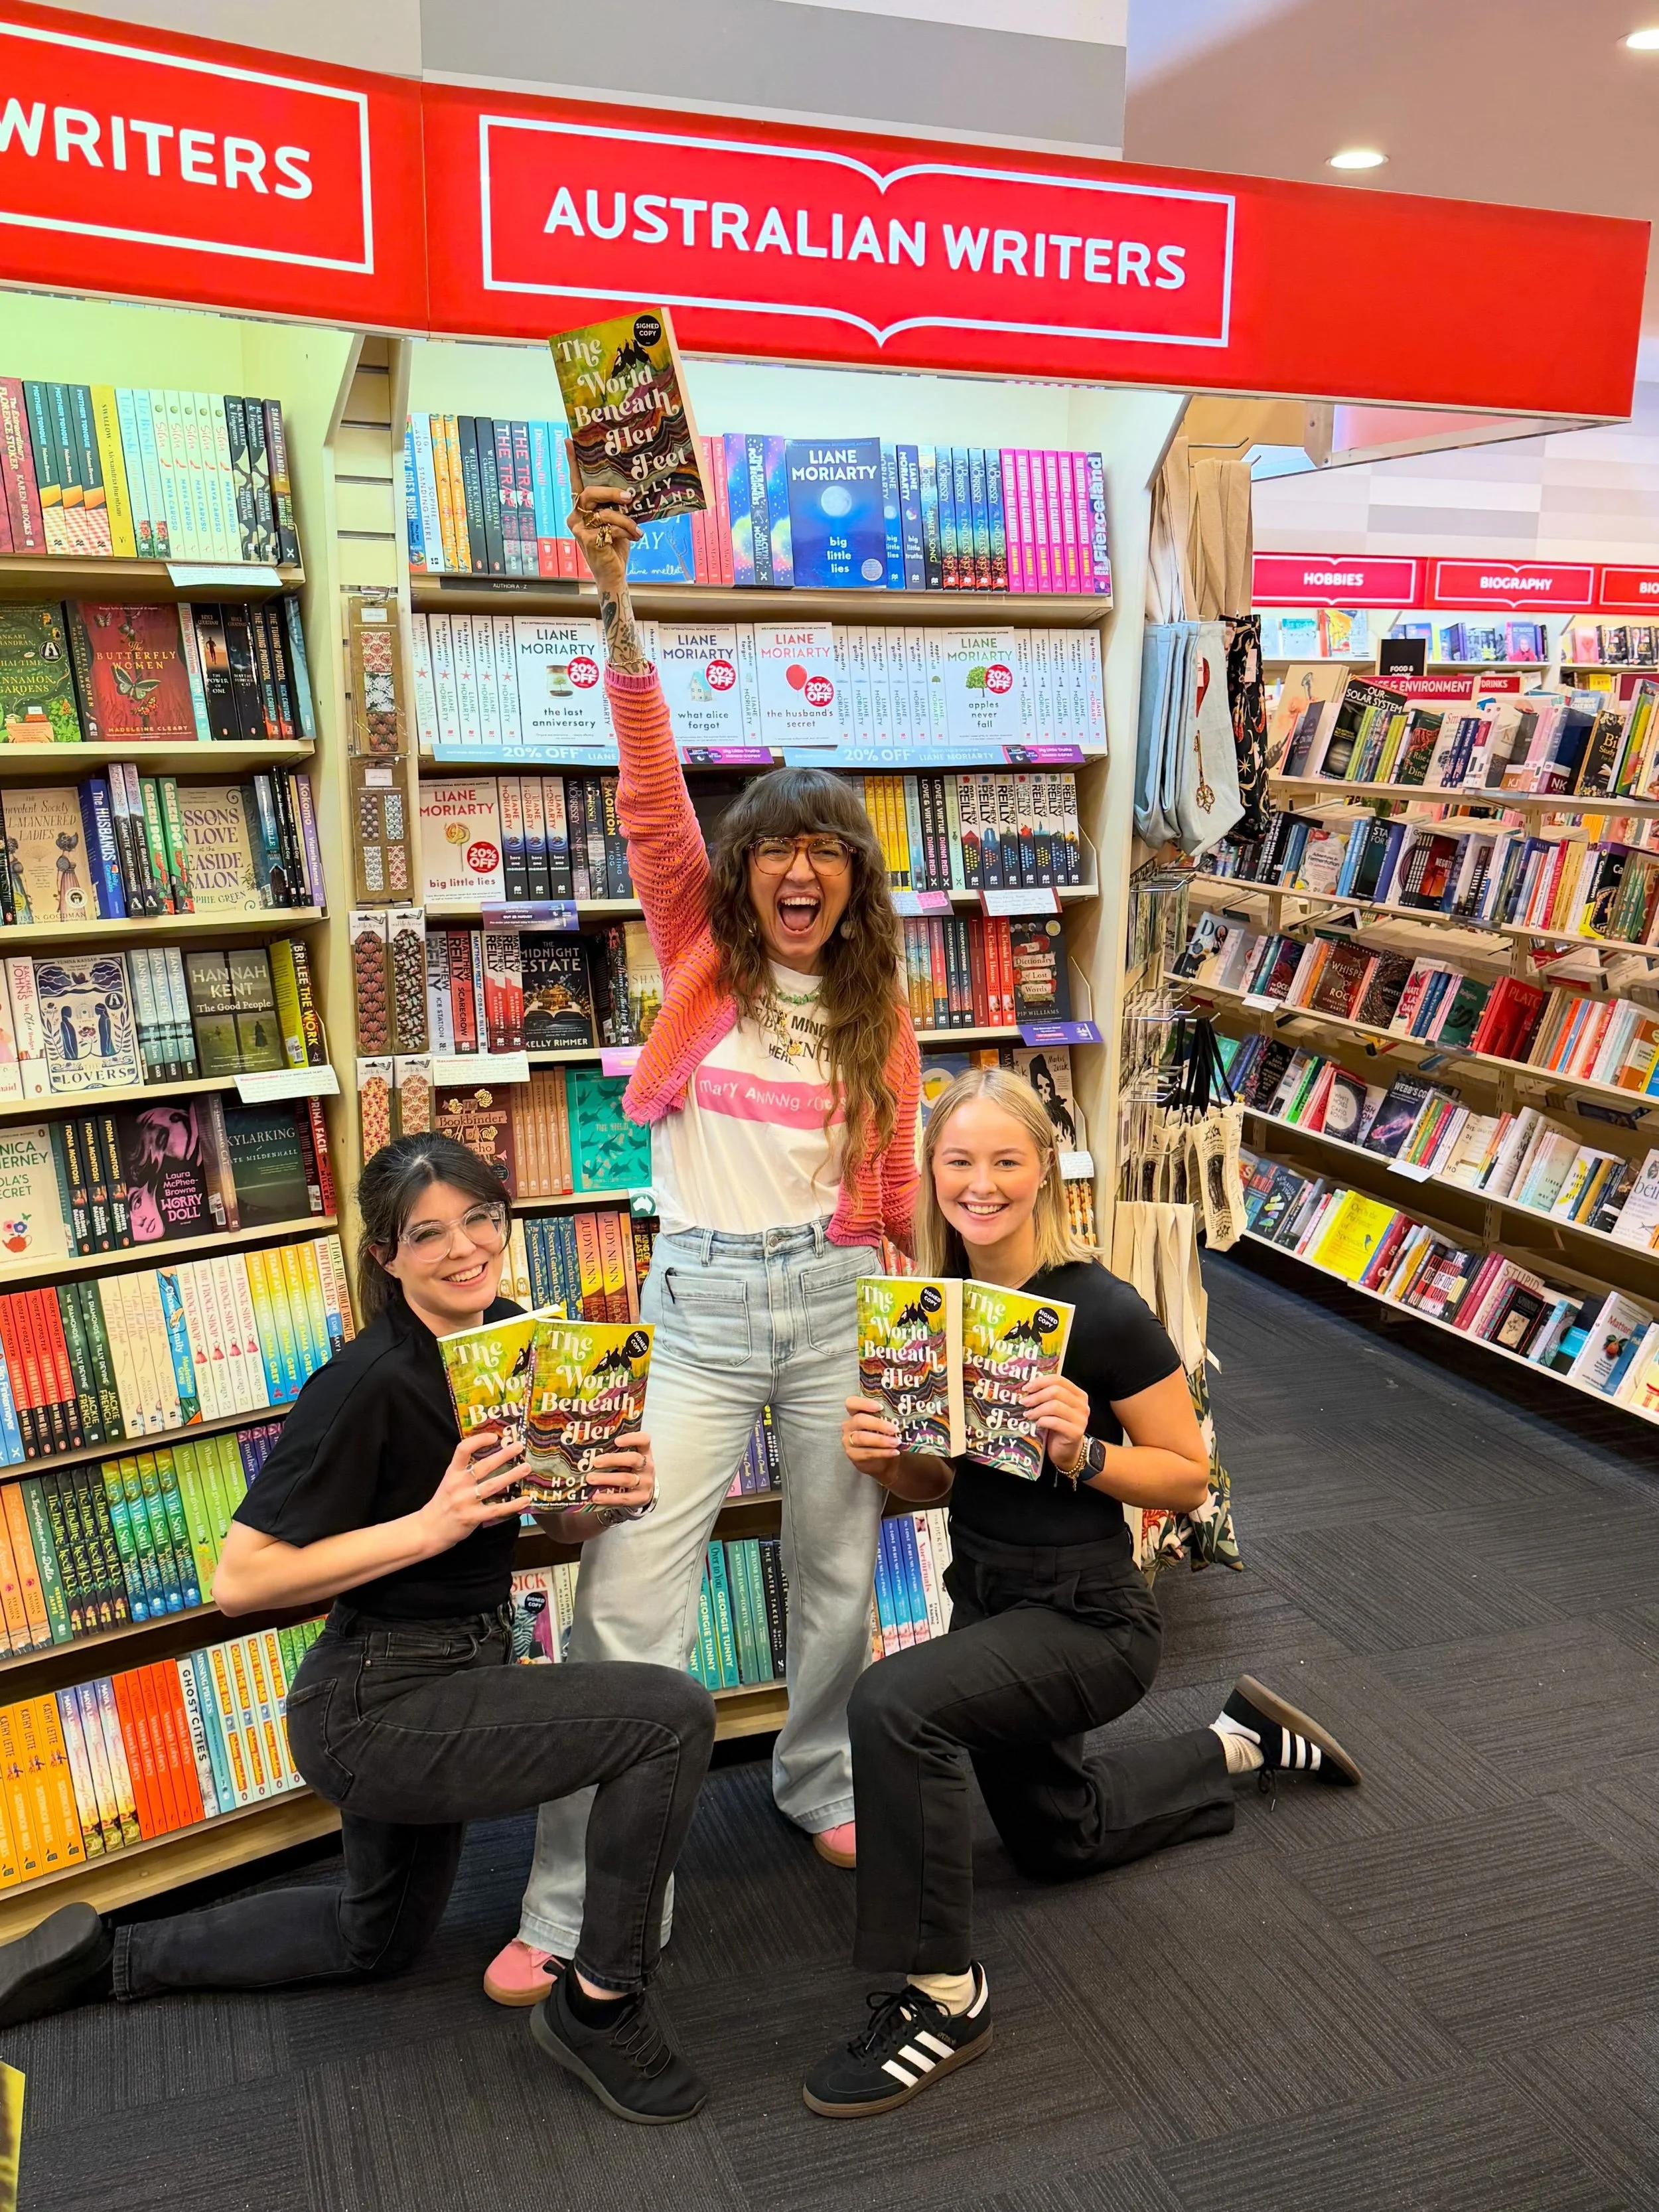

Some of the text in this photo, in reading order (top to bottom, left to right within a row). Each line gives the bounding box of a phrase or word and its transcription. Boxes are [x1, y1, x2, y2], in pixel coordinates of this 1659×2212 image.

[0, 97, 313, 201] WRITERS
[544, 185, 1187, 291] AUSTRALIAN WRITERS
[557, 338, 603, 367] The
[577, 365, 654, 398] World
[573, 388, 680, 427] Beneath
[497, 425, 511, 459] THE
[515, 425, 528, 459] THE
[604, 425, 657, 456] Her
[630, 447, 688, 480] Feet
[809, 449, 857, 465] LIANE
[791, 465, 877, 480] MORIARTY
[830, 536, 847, 548] big
[827, 551, 851, 560] little
[831, 564, 849, 573] lies
[1303, 573, 1364, 585] HOBBIES
[1480, 577, 1552, 591] BIOGRAPHY
[537, 629, 578, 641] LIANE
[678, 635, 717, 645] LIANE
[776, 634, 815, 644] LIANE
[522, 643, 595, 655] MORIARTY
[961, 638, 997, 648] LIANE
[96, 651, 177, 661] BUTTERFLY
[664, 649, 733, 659] MORIARTY
[761, 647, 830, 658] MORIARTY
[948, 651, 1013, 662] MORIARTY
[113, 661, 165, 670] WOMEN
[570, 662, 597, 673] 20%
[708, 665, 734, 676] 20%
[570, 672, 597, 684] OFF
[708, 676, 733, 686] OFF
[987, 669, 1011, 680] 20%
[807, 682, 832, 692] 20%
[987, 680, 1010, 690] OFF
[1399, 680, 1472, 693] ENVIRONMENT
[1481, 680, 1508, 689] DRINKS
[807, 692, 831, 703] OFF
[1367, 686, 1386, 699] OUR
[968, 700, 999, 709] apples
[1346, 688, 1403, 713] SOLAR SYSTEM
[544, 707, 583, 716] the last
[533, 719, 595, 728] anniversary
[688, 721, 719, 731] forgot
[502, 747, 542, 758] 20%
[844, 748, 879, 762] 20%
[435, 790, 476, 802] LIANE
[300, 782, 312, 825] Kokomo
[419, 803, 494, 817] MORIARTY
[924, 809, 933, 834] VIRTUE
[19, 829, 55, 842] LADIES
[100, 808, 115, 868] HUSBANDS
[196, 829, 238, 845] LOVE
[470, 848, 497, 859] 20%
[469, 857, 496, 868] OFF
[430, 877, 496, 889] big little lies
[520, 948, 579, 958] MIDNIGHT
[521, 958, 581, 972] ESTATE
[192, 966, 267, 984] HANNAH
[13, 964, 26, 1001] JOHNS
[210, 983, 254, 999] KENT
[1329, 989, 1354, 1002] ROCK
[197, 1000, 271, 1012] The Good People
[458, 988, 468, 1036] SCARECROW
[303, 1013, 318, 1047] WORK
[61, 1068, 128, 1084] LOVERS
[699, 1079, 738, 1096] mary
[1394, 1082, 1417, 1096] WEBB'S
[439, 1115, 504, 1126] Bookbinder
[165, 1170, 190, 1181] Laura
[163, 1178, 198, 1189] McPhee-
[165, 1186, 196, 1196] Browne
[161, 1194, 202, 1211] WORRY
[168, 1207, 201, 1222] DOLL
[581, 1220, 597, 1285] JUDY NUNN
[604, 1219, 618, 1283] JUDY NUNN
[861, 1285, 894, 1313] The
[924, 1289, 942, 1303] SIGNED
[924, 1296, 938, 1306] COPY
[968, 1291, 1006, 1324] The
[1037, 1316, 1053, 1328] COPY
[1038, 1309, 1058, 1326] SIGNED
[871, 1316, 928, 1342] World
[547, 1330, 593, 1361] The
[630, 1339, 642, 1353] COPY
[634, 1332, 648, 1351] SIGNED
[972, 1325, 1039, 1361] World
[453, 1341, 504, 1368] The
[864, 1340, 944, 1373] Beneath
[555, 1365, 629, 1390] World
[881, 1368, 923, 1390] Her
[972, 1378, 1023, 1406] Her
[79, 1393, 91, 1430] FRENCH
[541, 1392, 640, 1420] Beneath
[898, 1394, 943, 1416] Feet
[986, 1408, 1038, 1438] Feet
[561, 1420, 615, 1445] Her
[512, 1572, 546, 1592] SICK
[700, 1595, 715, 1670] GEORGIE TUNNY
[717, 1591, 733, 1667] GEORGIE TUNNY
[182, 1669, 207, 1762] GHOST CITIES
